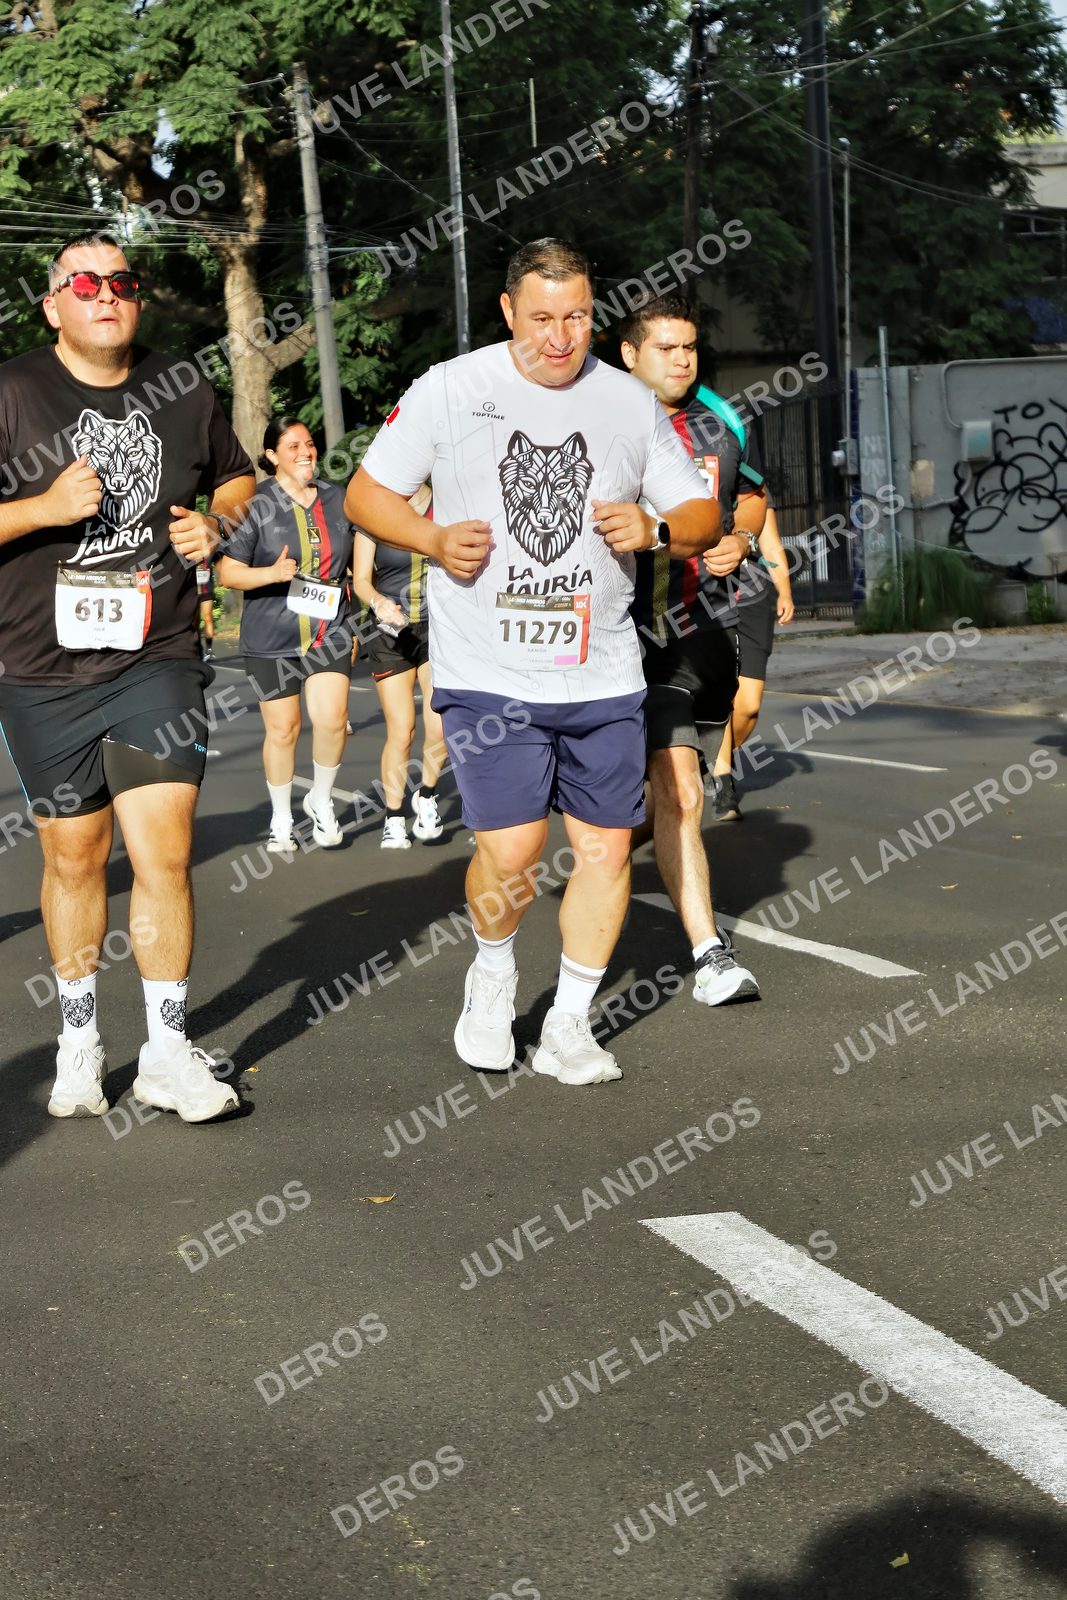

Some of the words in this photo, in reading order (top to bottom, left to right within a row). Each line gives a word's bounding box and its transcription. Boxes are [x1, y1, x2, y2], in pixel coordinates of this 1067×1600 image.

[472, 411, 505, 421] TOPTIME
[85, 521, 106, 537] LA
[66, 522, 153, 564] JAURÍA
[508, 565, 533, 581] LA
[301, 586, 326, 603] 996
[75, 597, 123, 623] 613
[499, 618, 577, 645] 11279
